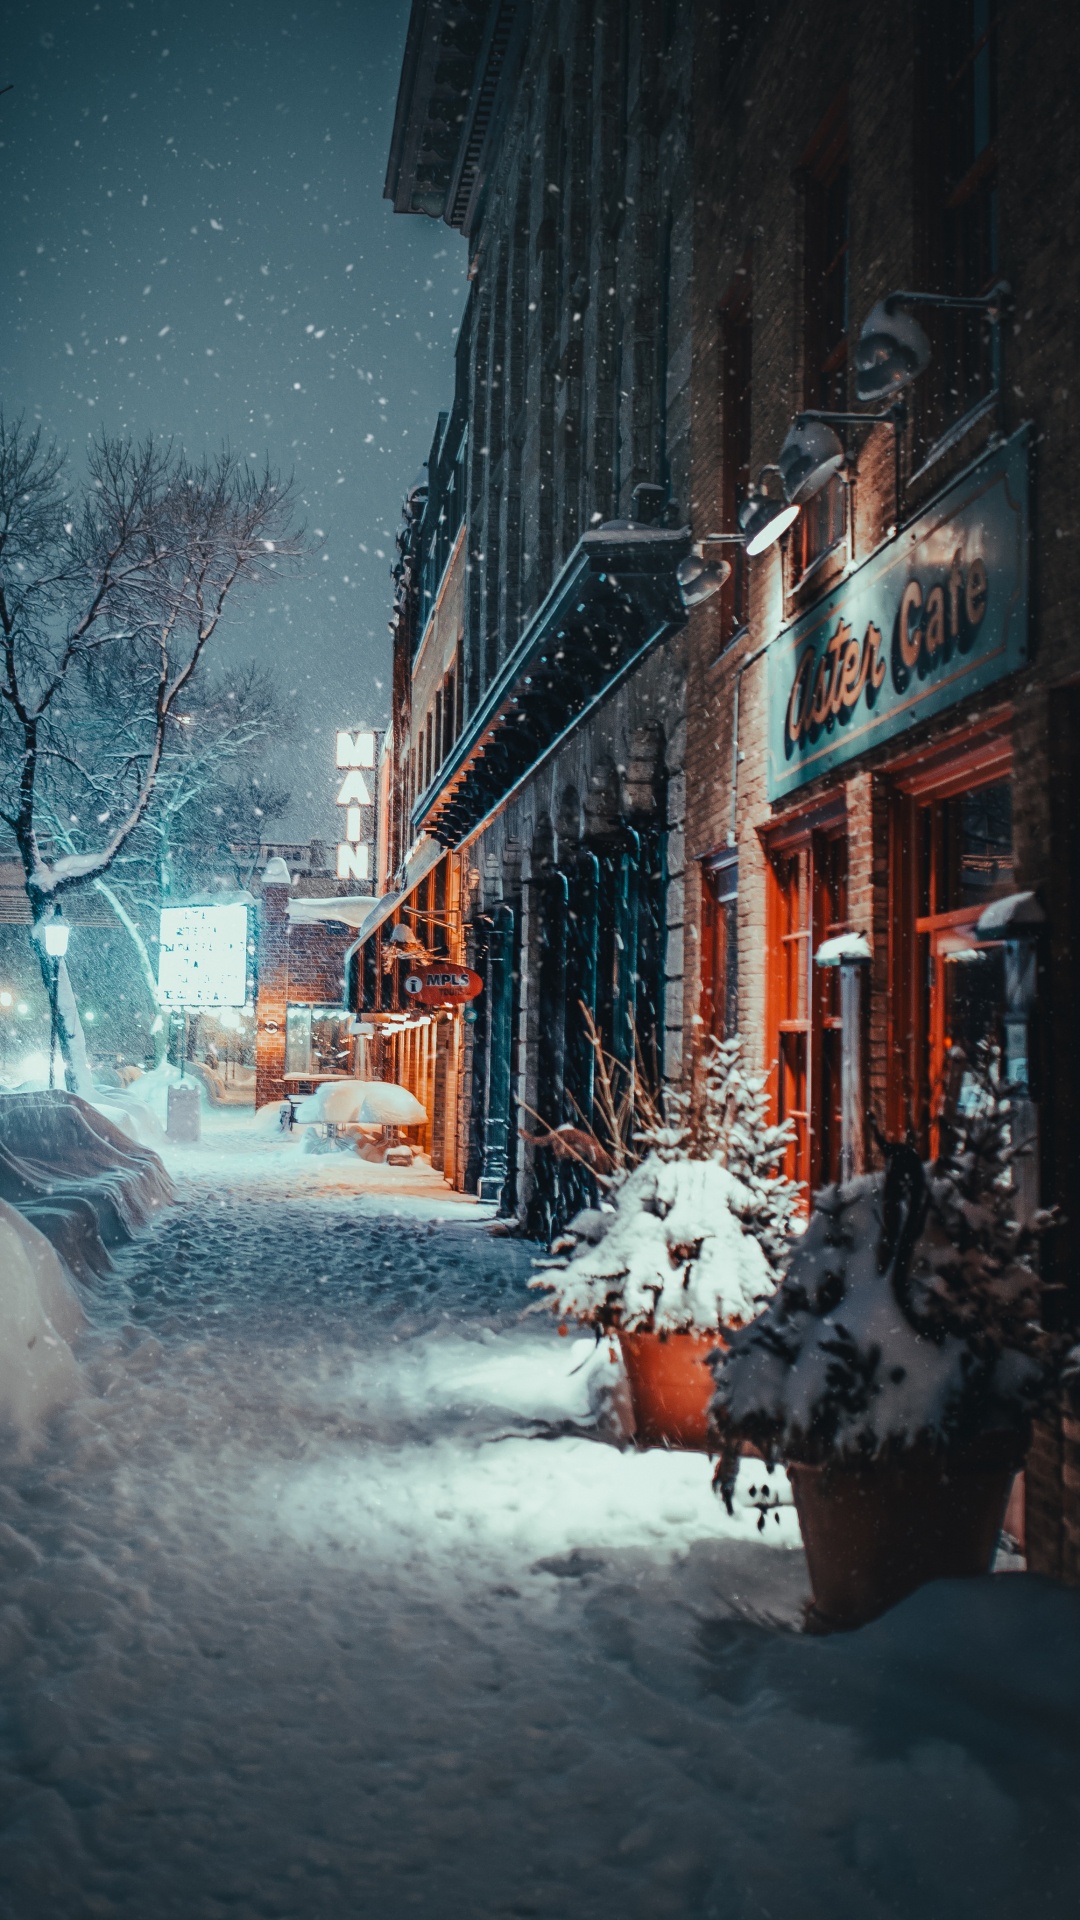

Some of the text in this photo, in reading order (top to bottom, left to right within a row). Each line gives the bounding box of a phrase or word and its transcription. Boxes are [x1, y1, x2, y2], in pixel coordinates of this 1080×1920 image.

[788, 547, 988, 743] Aster Cafe
[336, 732, 375, 880] MAIN
[426, 974, 469, 987] MPLS
